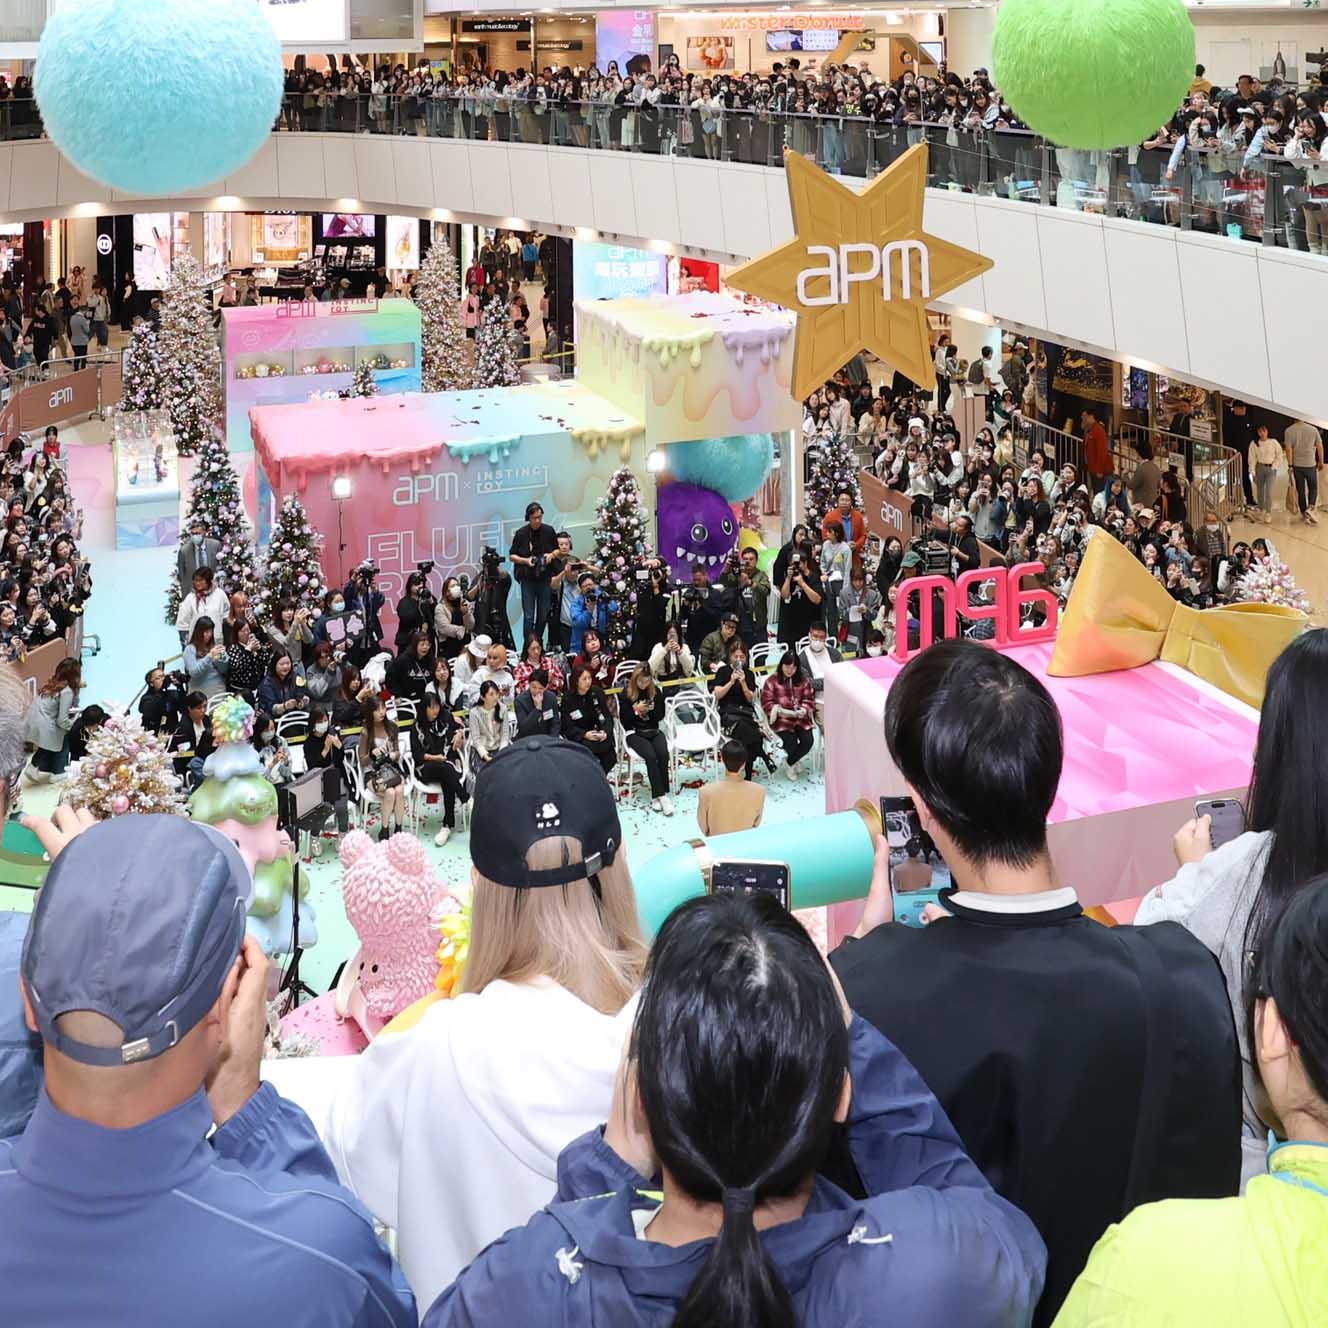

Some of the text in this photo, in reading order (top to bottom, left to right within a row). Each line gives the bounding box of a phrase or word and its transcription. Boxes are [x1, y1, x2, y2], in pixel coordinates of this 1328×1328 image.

[796, 239, 931, 307] apm
[48, 386, 73, 409] apm
[392, 472, 459, 506] apm
[880, 501, 904, 531] apm
